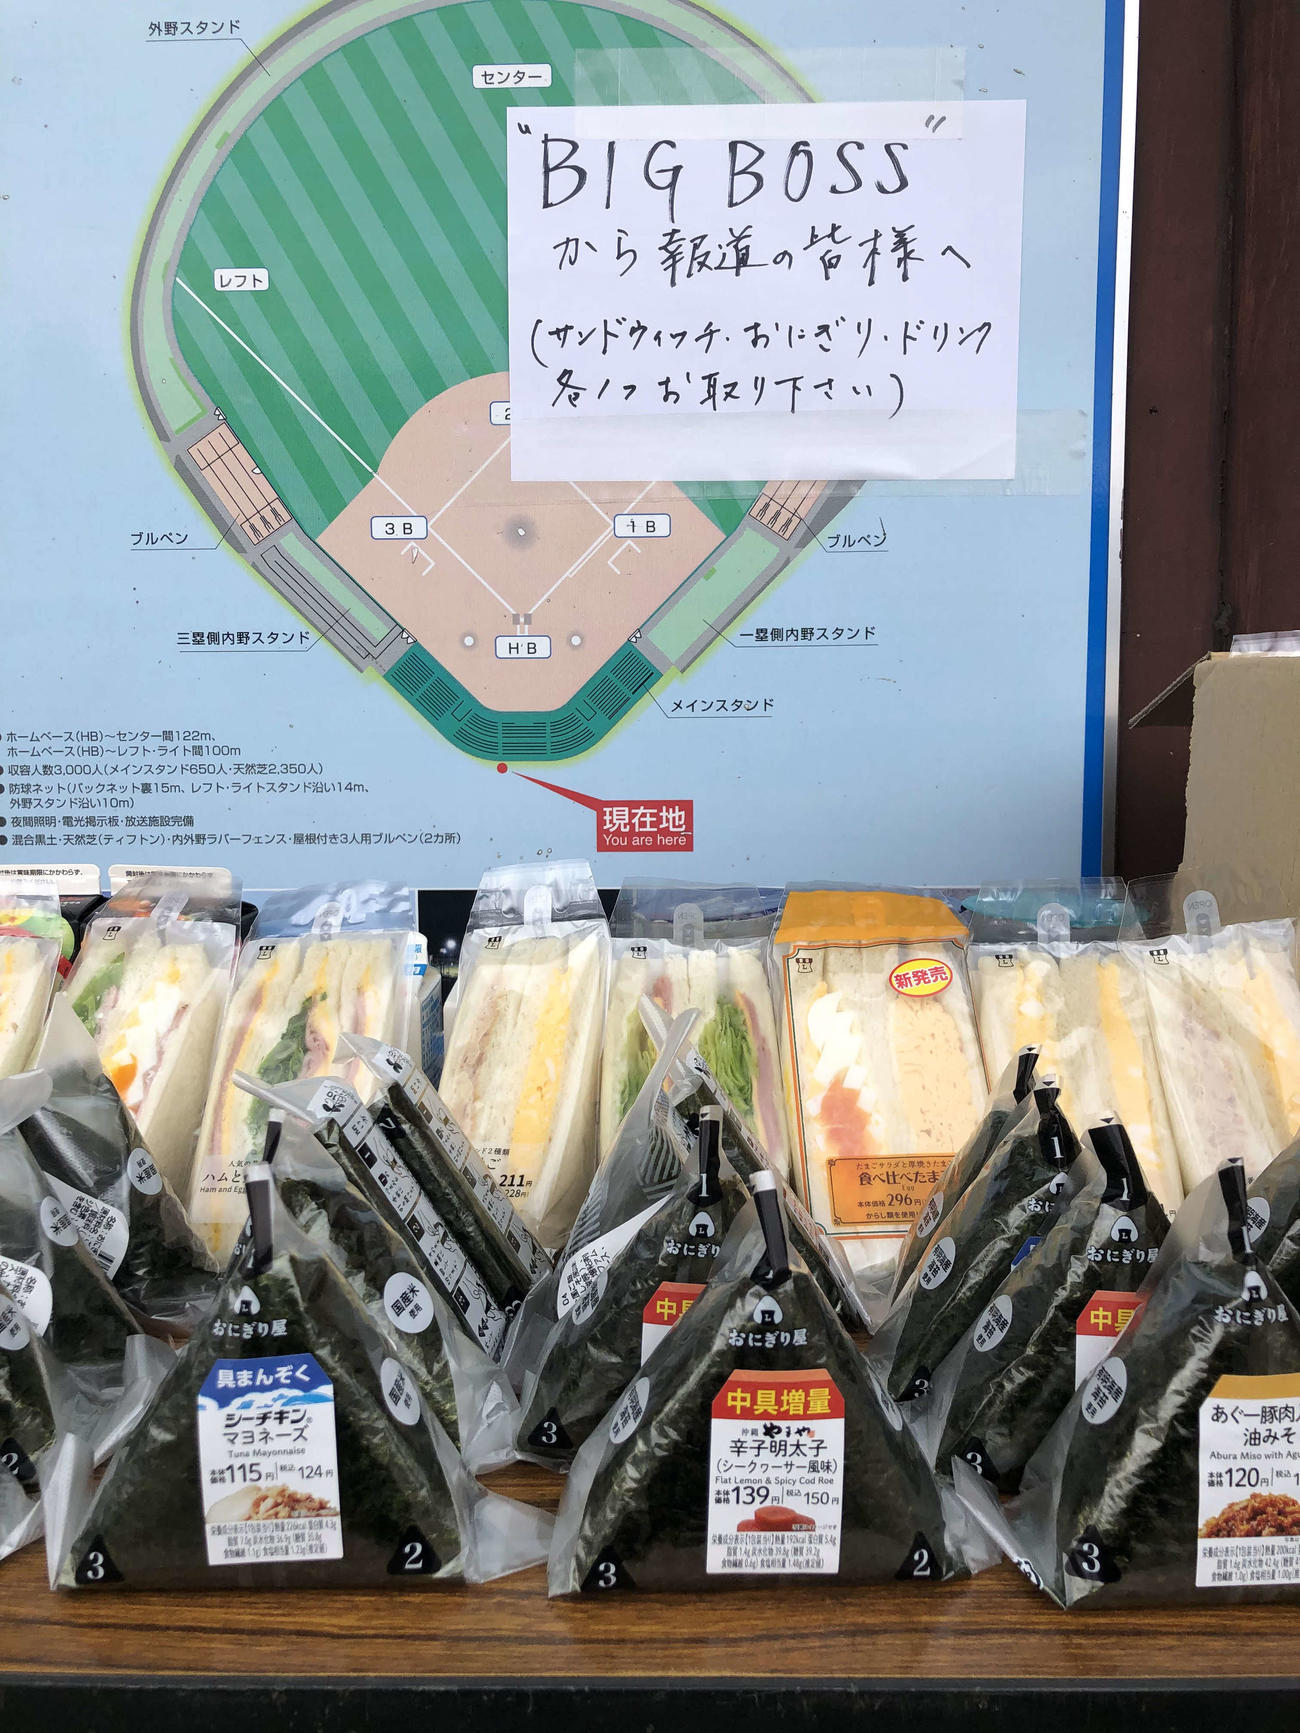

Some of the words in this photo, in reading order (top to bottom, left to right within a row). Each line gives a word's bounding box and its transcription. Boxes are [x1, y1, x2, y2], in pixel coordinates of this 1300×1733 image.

[148, 19, 241, 36] 外野スタンド
[481, 69, 542, 84] センター
[554, 224, 970, 287] から報道の皆様へ
[220, 273, 263, 288] レフト
[131, 532, 188, 545] ブルペン
[828, 534, 886, 548] ブルペン
[177, 631, 310, 646] 三塁側内野スタンド
[740, 626, 876, 641] 一塁側内野スタンド
[671, 699, 774, 712] メインスタンド
[11, 816, 194, 828] 夜間照明・電光掲示板・放送施設完備
[602, 806, 686, 833] 現在地
[603, 833, 627, 847] You
[629, 836, 650, 845] are
[653, 833, 687, 846] here
[894, 966, 949, 990] 新発売
[1050, 1136, 1064, 1159] 1
[500, 1174, 533, 1188] 211円
[698, 1173, 710, 1197] 1
[1120, 1177, 1130, 1201] 1
[888, 1194, 922, 1206] 296円
[1087, 1246, 1160, 1264] おにぎり屋
[390, 1282, 420, 1318] 国産米
[1214, 1304, 1288, 1326] おにぎり屋
[212, 1318, 288, 1339] おにぎり屋
[728, 1328, 808, 1348] おにぎり屋
[216, 1364, 311, 1388] 具まんぞく
[727, 1388, 832, 1416] 中具増量
[223, 1424, 309, 1445] マヨネーズ
[542, 1421, 558, 1444] 3
[1243, 1427, 1296, 1446] 油みそ
[228, 1450, 250, 1458] Tuna
[252, 1447, 306, 1458] Mayonnaise
[730, 1438, 828, 1458] 辛子明太子
[1210, 1451, 1238, 1460] Abura
[1240, 1452, 1262, 1460] Miso
[1264, 1450, 1284, 1459] with
[714, 1476, 732, 1484] Flat
[734, 1476, 763, 1484] Lemon
[765, 1476, 772, 1484] &
[774, 1476, 796, 1486] Spicy
[799, 1476, 816, 1485] Cod
[818, 1476, 834, 1484] Roe
[786, 1488, 801, 1497] 税込
[87, 1552, 104, 1580] 3
[404, 1542, 424, 1570] 2
[913, 1548, 931, 1576] 2
[1082, 1542, 1100, 1574] 3
[598, 1562, 617, 1588] 3
